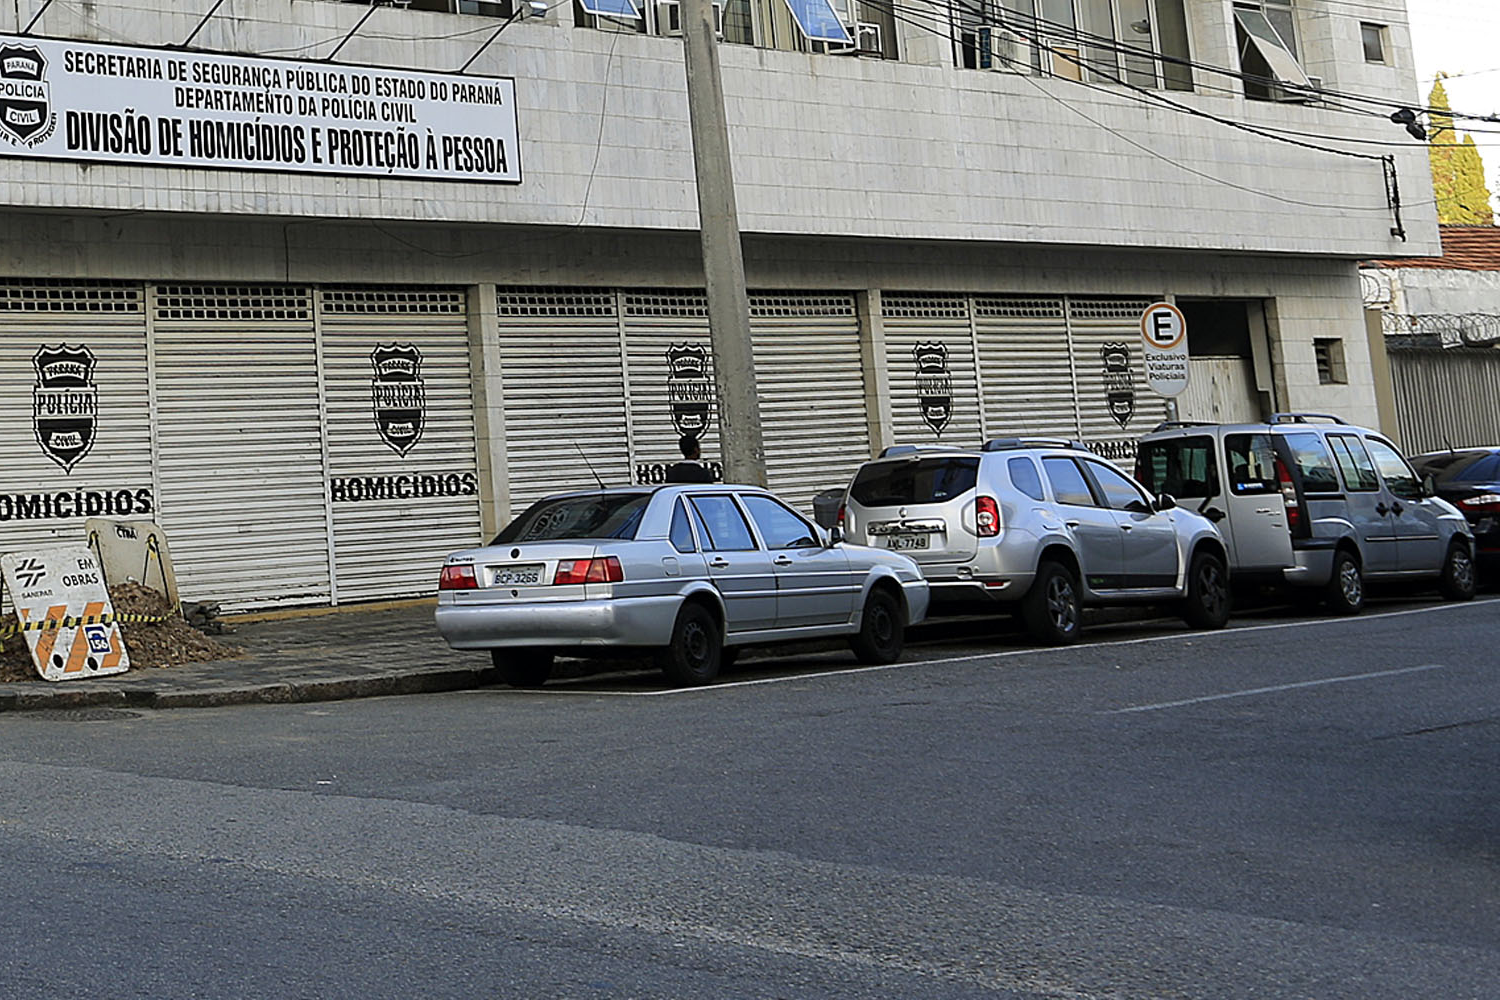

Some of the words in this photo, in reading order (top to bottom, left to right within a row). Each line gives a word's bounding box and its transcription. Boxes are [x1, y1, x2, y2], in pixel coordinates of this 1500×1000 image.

[64, 50, 163, 80] SECRETARIA
[168, 60, 188, 82] DE
[192, 62, 281, 93] SEGURANÇA
[286, 66, 347, 94] PÚBLICA
[352, 76, 370, 96] DO
[376, 77, 425, 100] ESTADO
[430, 81, 448, 101] DO
[452, 82, 502, 105] PARANÁ
[175, 87, 292, 115] DEPARTAMENTO
[299, 96, 317, 117] DA
[322, 95, 377, 121] POLÍCIA
[381, 102, 417, 123] CIVIL
[9, 111, 36, 123] CIVIL
[66, 108, 149, 156] DIVISÃO
[158, 117, 183, 157] DE
[188, 117, 306, 163] HOMICÍDIOS
[311, 127, 323, 164] E
[328, 126, 419, 174] PROTEÇÃO
[426, 128, 438, 170] À
[442, 135, 508, 173] PESSOA
[1152, 311, 1174, 341] E
[1145, 353, 1186, 362] Exclusivo
[1148, 362, 1186, 371] Viaturas
[1150, 372, 1186, 380] Policiais
[37, 388, 94, 415] POLÍCIA
[330, 471, 478, 502] HOMICÍDIOS
[77, 558, 95, 570] EM
[62, 573, 99, 587] OBRAS
[91, 639, 108, 650] 156
